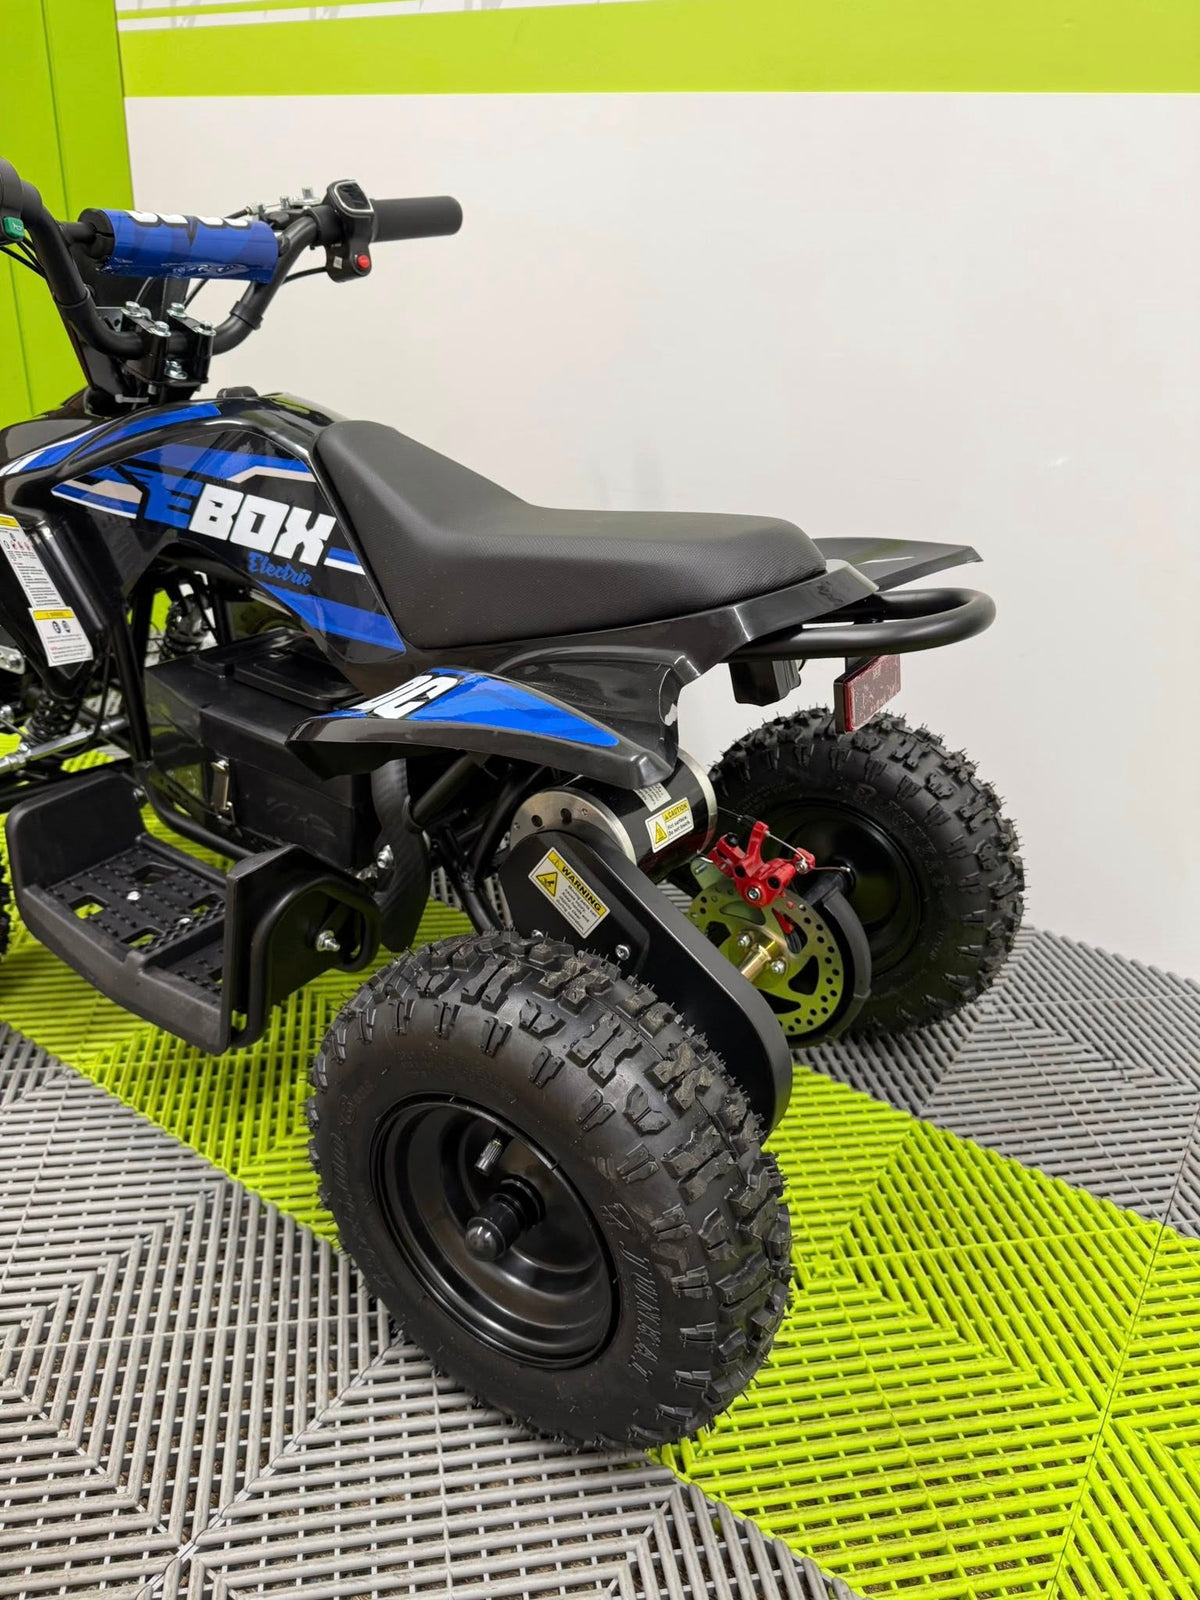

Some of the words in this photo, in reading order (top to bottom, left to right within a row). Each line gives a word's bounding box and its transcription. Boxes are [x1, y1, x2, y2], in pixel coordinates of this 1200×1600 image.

[248, 552, 313, 587] Electric
[668, 803, 688, 818] CAUTION
[561, 866, 601, 911] WARNING
